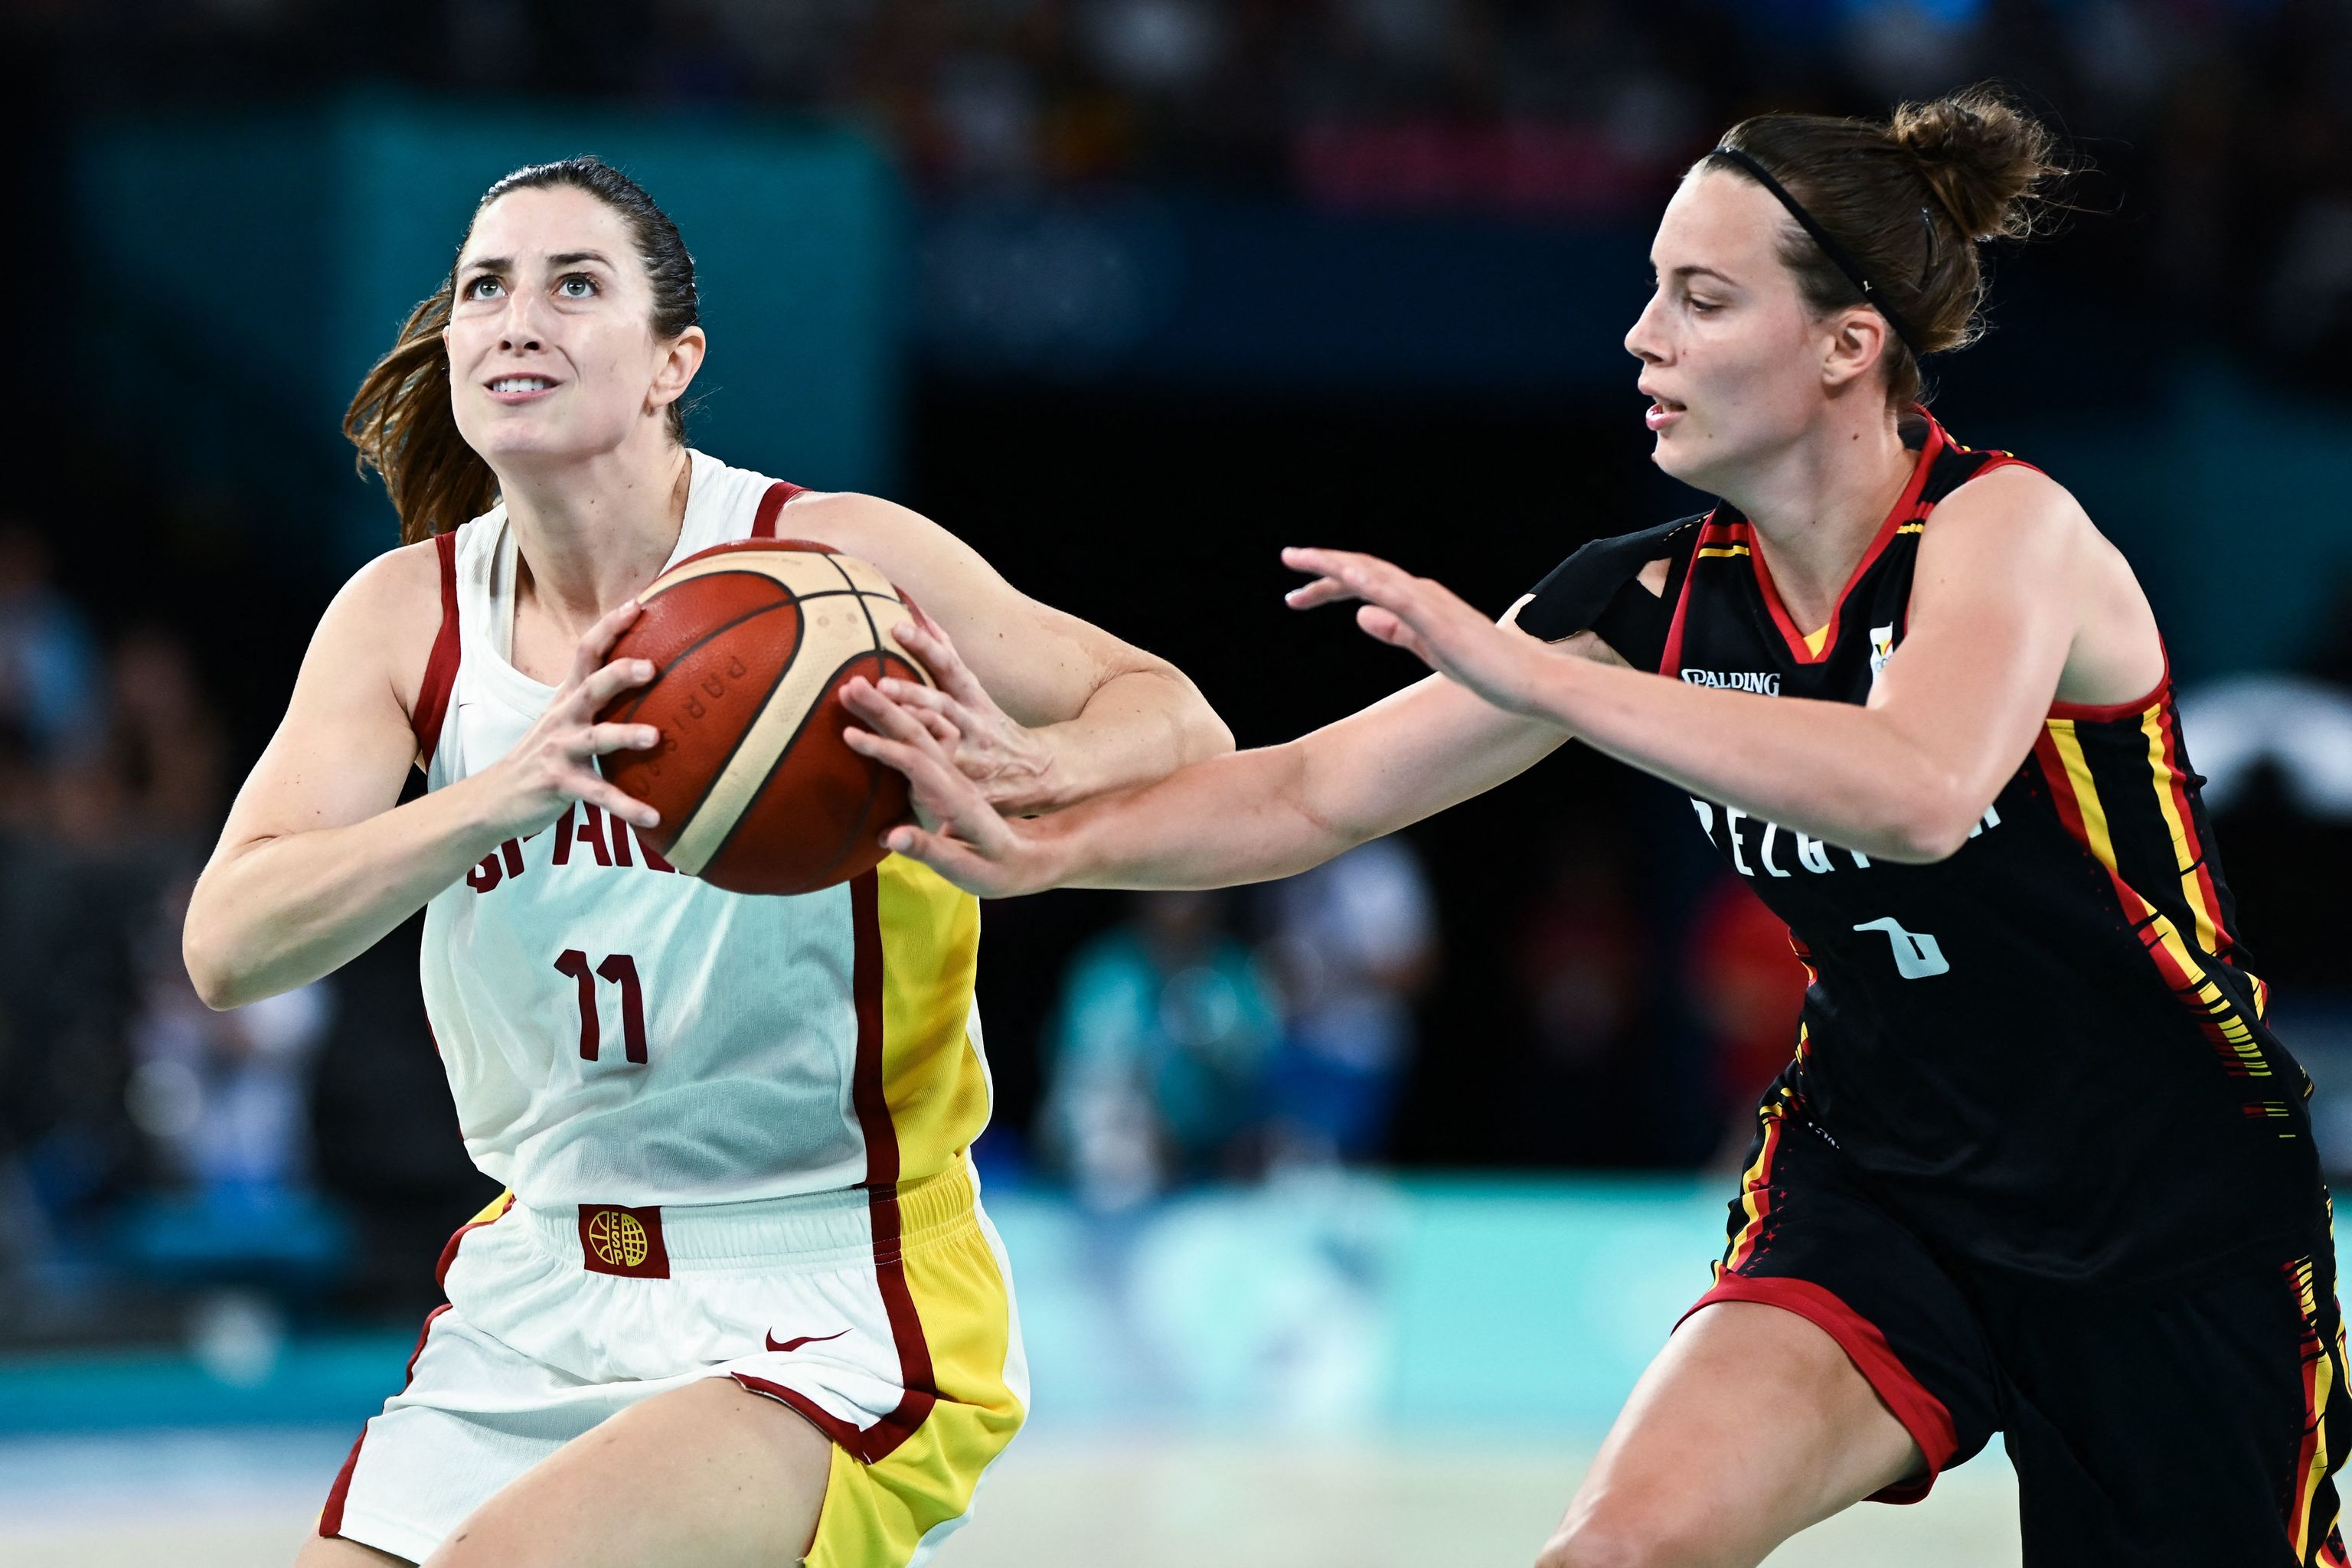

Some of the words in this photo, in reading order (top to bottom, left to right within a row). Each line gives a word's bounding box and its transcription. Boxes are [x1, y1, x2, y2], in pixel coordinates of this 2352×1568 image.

[1681, 668, 1781, 698] SPALDING
[553, 949, 648, 1065] 11
[611, 1211, 624, 1266] ESP
